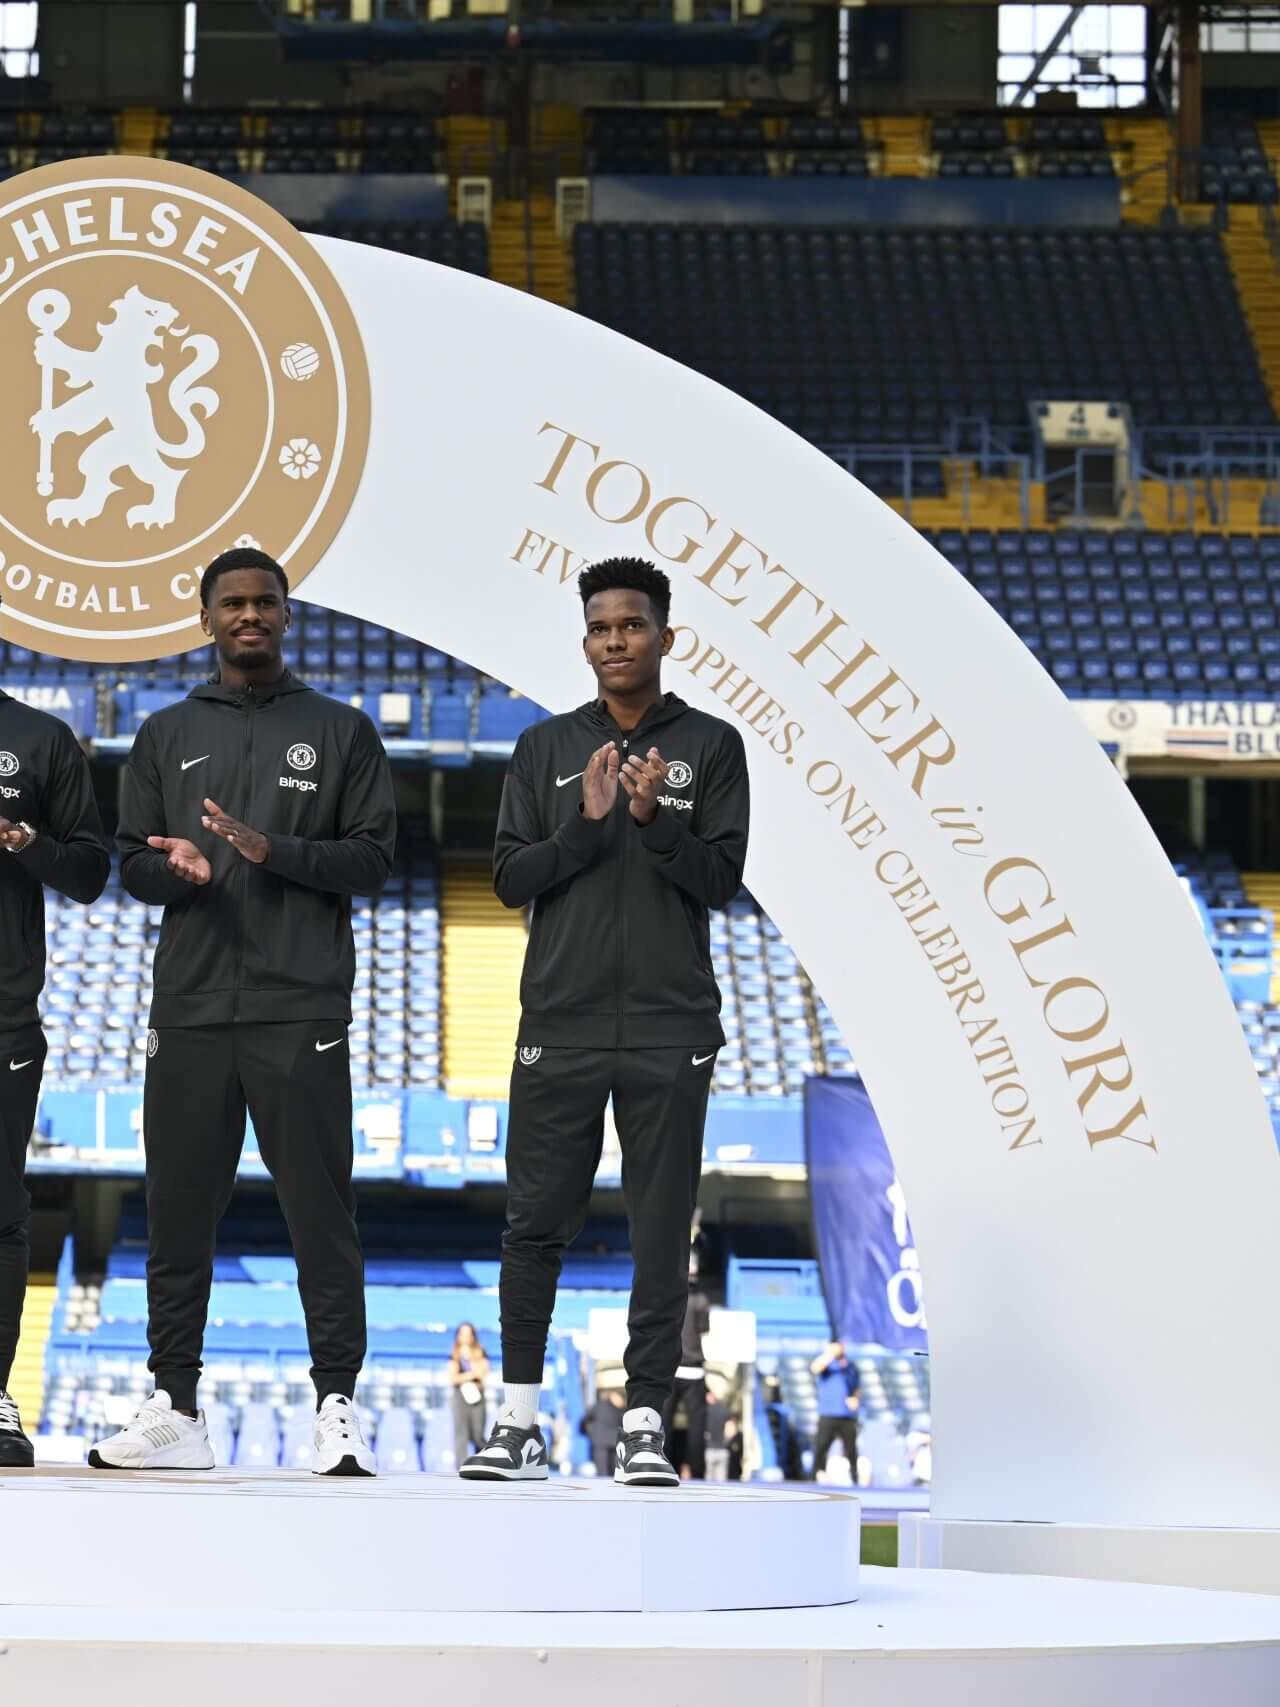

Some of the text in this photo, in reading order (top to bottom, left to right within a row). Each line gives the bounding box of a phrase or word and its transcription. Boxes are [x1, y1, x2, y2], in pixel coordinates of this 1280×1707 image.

[510, 528, 1044, 1151] FIV OPHIES. ONE CELEBRATION
[533, 421, 1158, 1152] TOGETHER in GLORY
